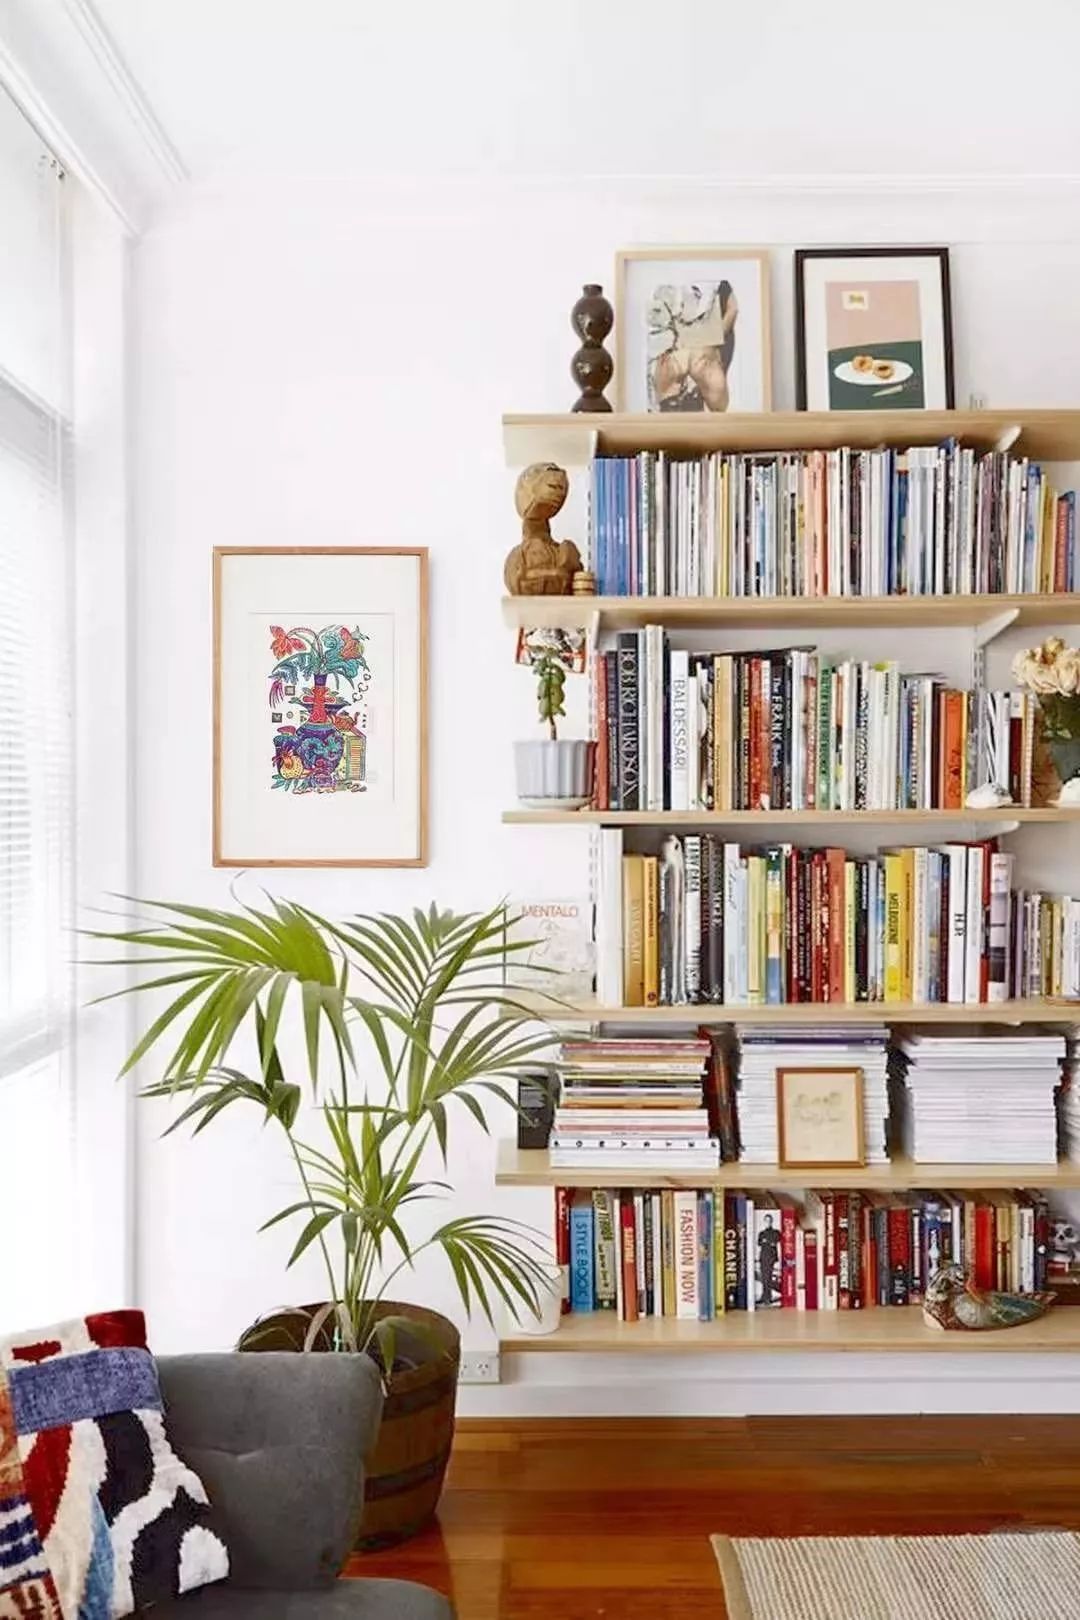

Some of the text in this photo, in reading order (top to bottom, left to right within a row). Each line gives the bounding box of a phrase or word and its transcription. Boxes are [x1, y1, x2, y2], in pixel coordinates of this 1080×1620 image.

[620, 647, 637, 798] BOB RICHARDSON
[673, 679, 686, 770] BALDESSARI
[771, 695, 784, 741] FRANK
[521, 904, 578, 918] MENTALO
[888, 893, 899, 944] MELBOURNE
[575, 1222, 588, 1297] STYLE BOOK
[680, 1209, 694, 1304] FASHION NOW
[725, 1229, 737, 1290] CHANEL
